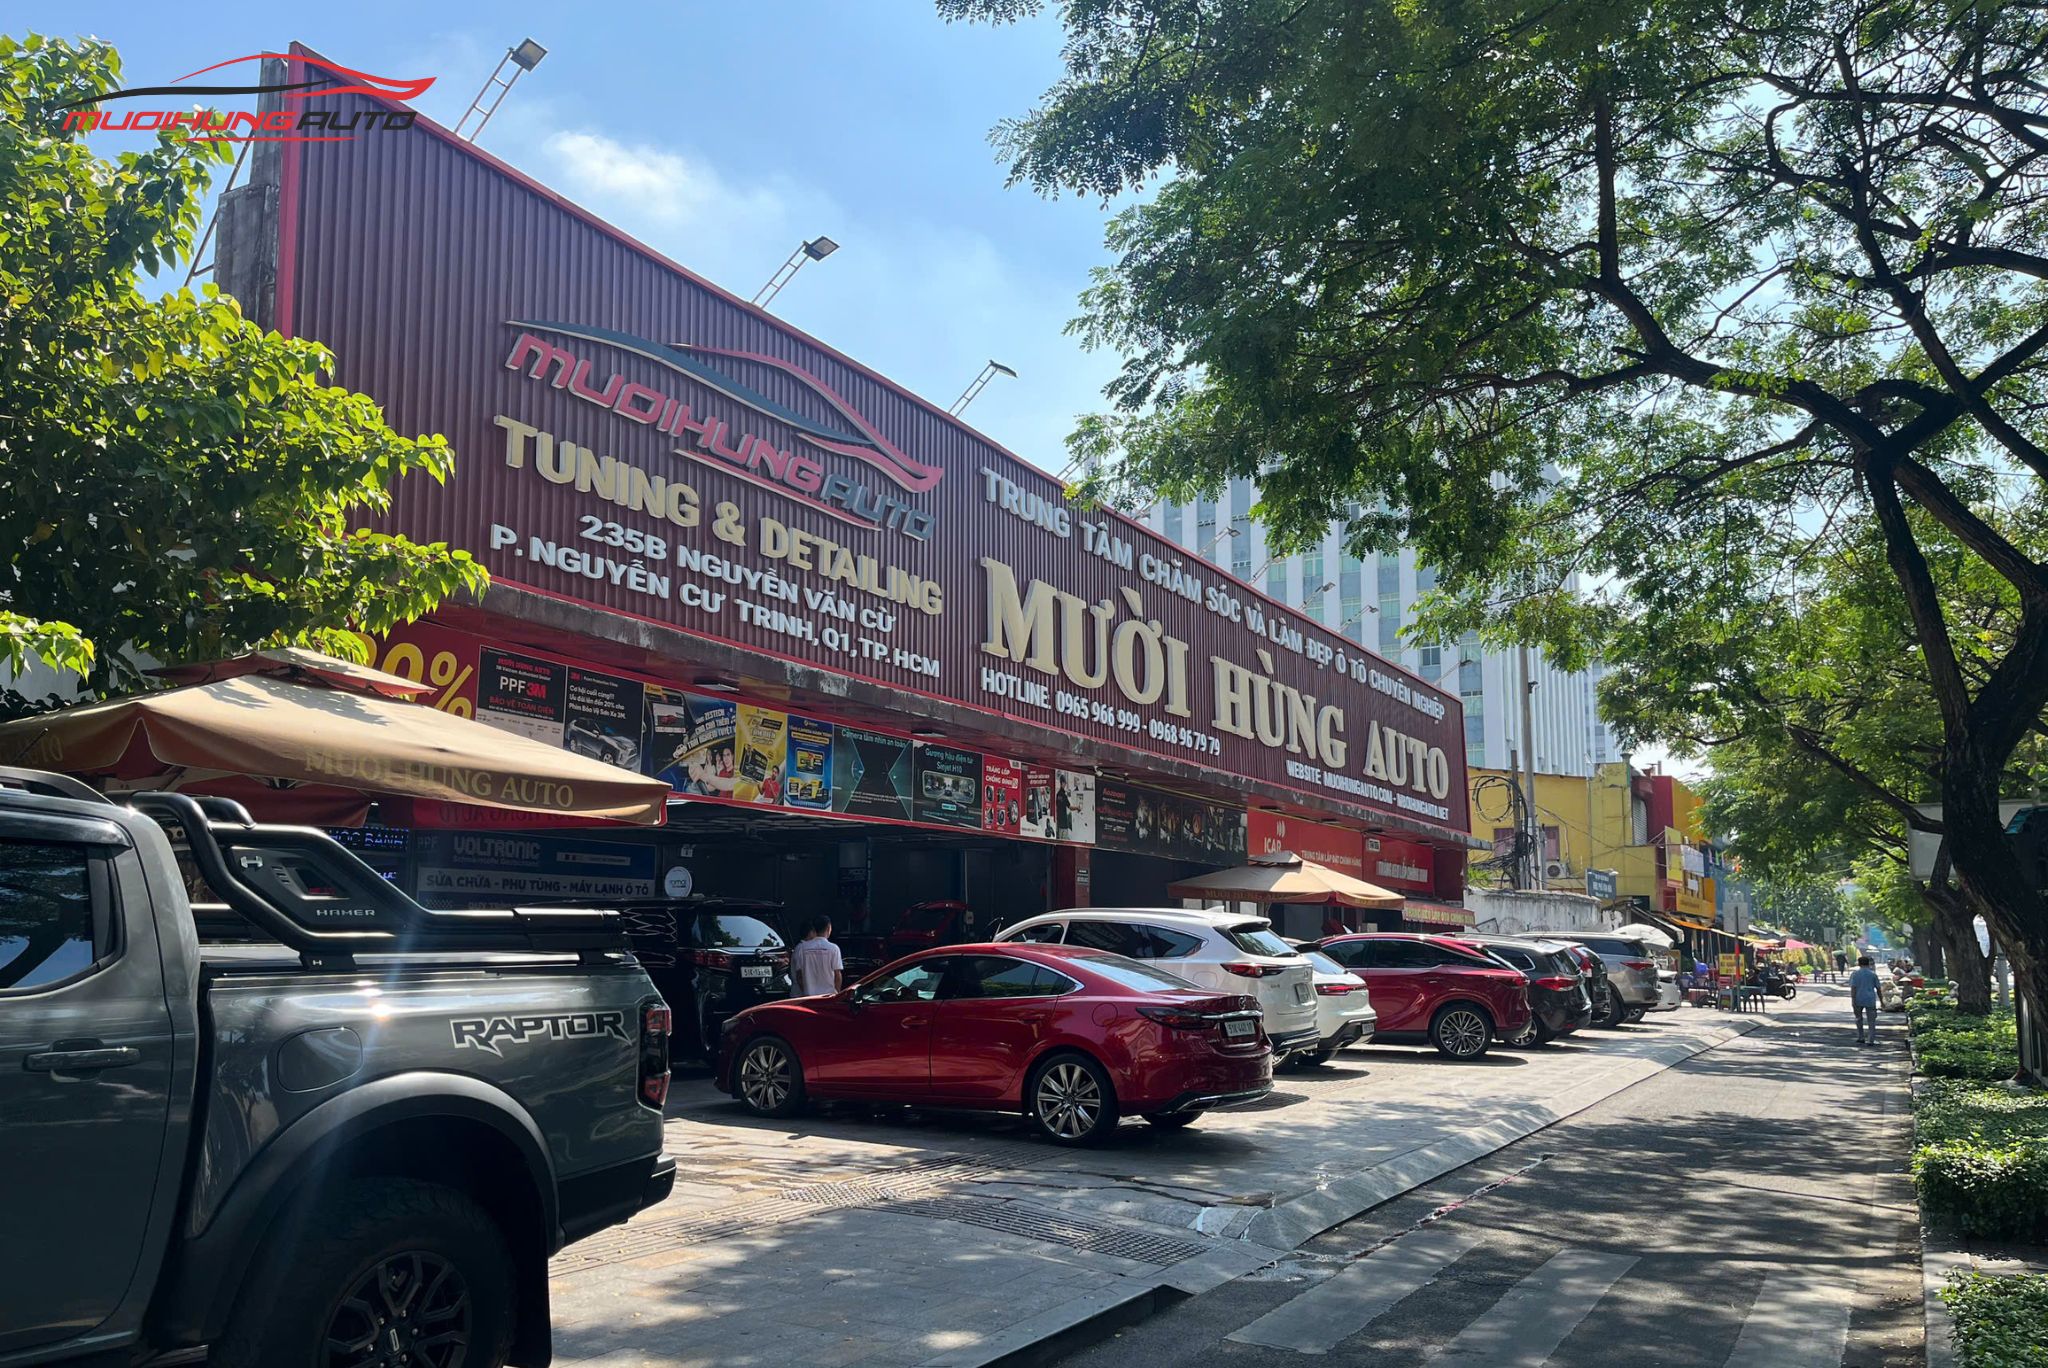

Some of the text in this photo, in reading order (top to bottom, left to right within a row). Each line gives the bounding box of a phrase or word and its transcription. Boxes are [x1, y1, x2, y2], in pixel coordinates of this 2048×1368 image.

[493, 414, 943, 616] TUNING & DETAILING
[529, 536, 670, 600] NGUYỄN
[679, 583, 726, 614] CƯ
[579, 514, 897, 633] 235B NGUYỄN VĂN CỪ
[979, 466, 1445, 725] TRUNG TÂM CHĂM SÓC VÀ LÀM ĐẸP Ô TÔ CHUYÊN NGHIỆP
[499, 675, 547, 699] PPF 3M
[979, 555, 1450, 800] MƯỜI HÙNG AUTO
[841, 728, 863, 741] Camera
[1055, 690, 1089, 720] 0965
[1091, 702, 1116, 728] 966
[1117, 709, 1141, 733] 999
[1148, 718, 1178, 745] 0968
[500, 776, 574, 808] AUTO
[453, 835, 541, 859] VOLTRONIC
[427, 870, 453, 887] SỬA
[456, 872, 492, 889] CHỮA
[502, 878, 526, 893] PHỤ
[530, 877, 560, 894] TÙNG
[569, 880, 591, 894] MÁY
[593, 882, 622, 896] LẠNH
[635, 882, 649, 896] TÔ
[449, 1010, 633, 1059] RAPTOR
